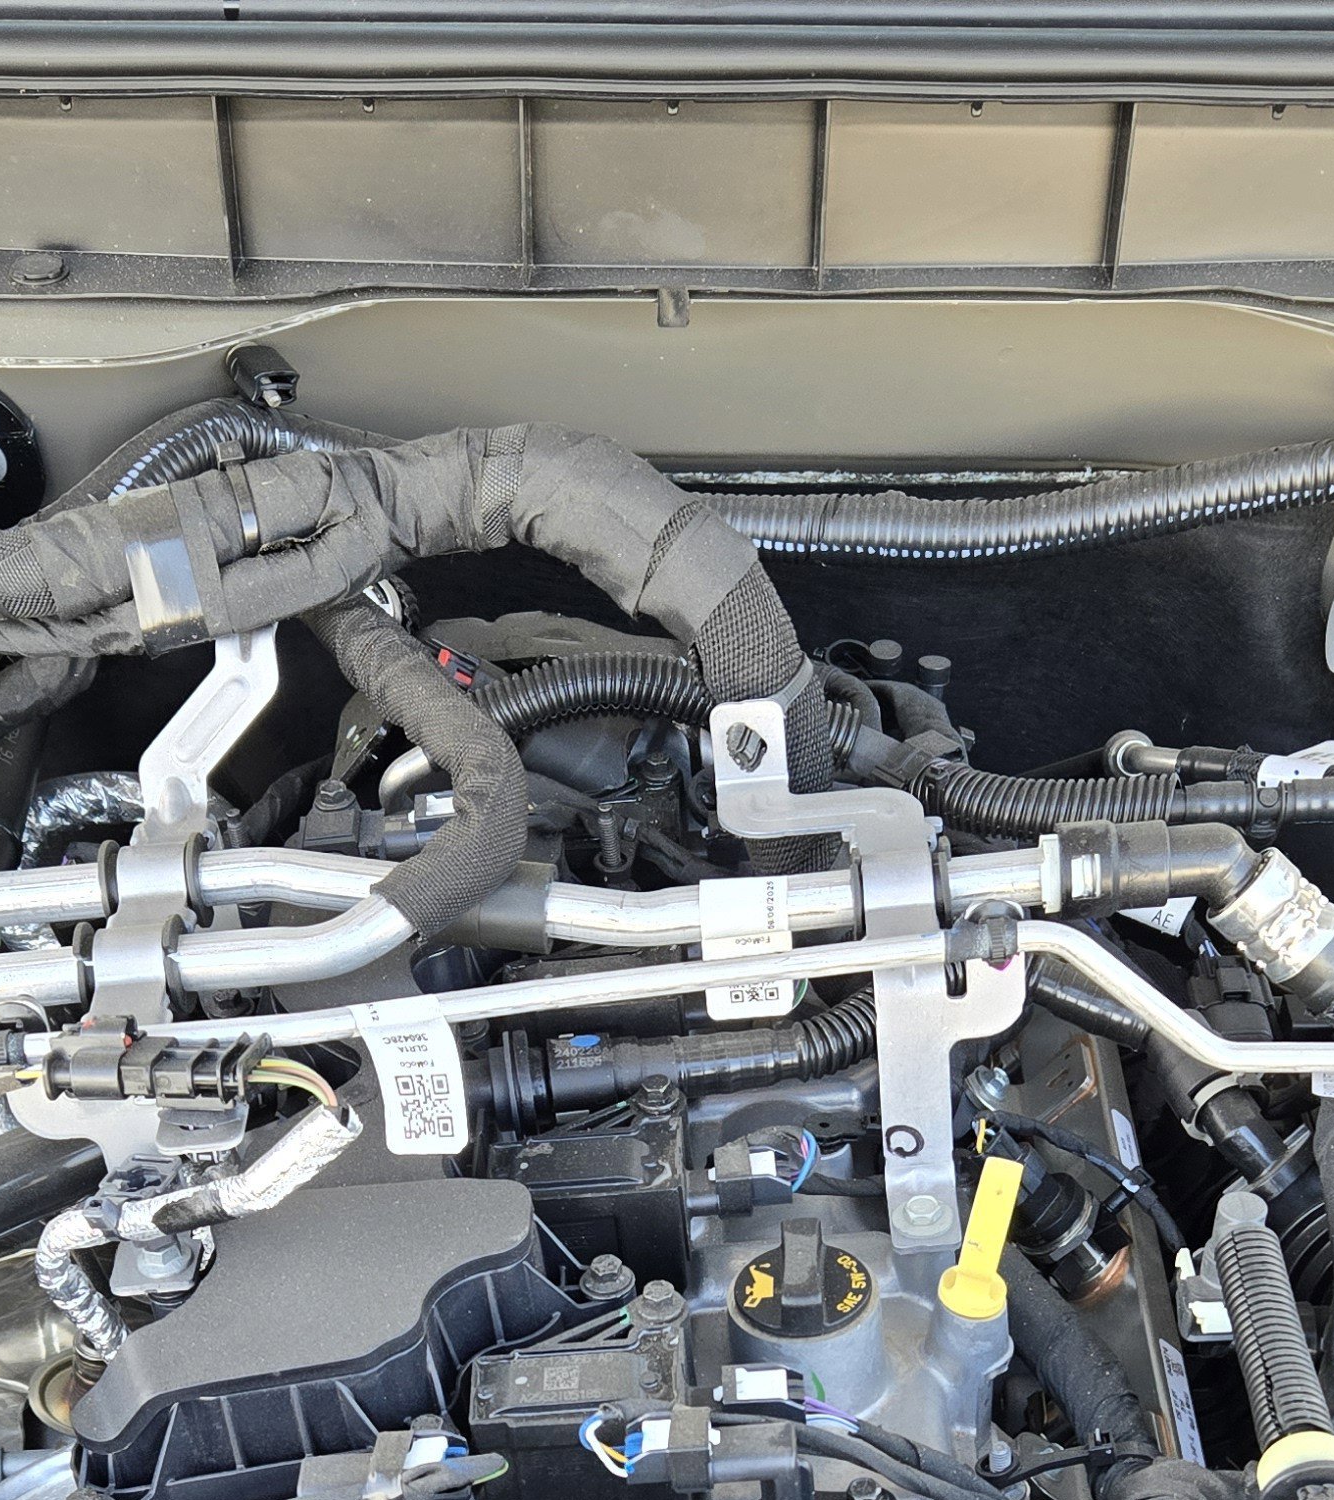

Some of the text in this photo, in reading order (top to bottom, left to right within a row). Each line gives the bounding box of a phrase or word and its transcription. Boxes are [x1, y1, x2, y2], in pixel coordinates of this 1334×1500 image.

[735, 935, 771, 945] FoMoCo
[400, 1060, 435, 1068] FoMoCo
[836, 1255, 867, 1313] SAE 5W-30
